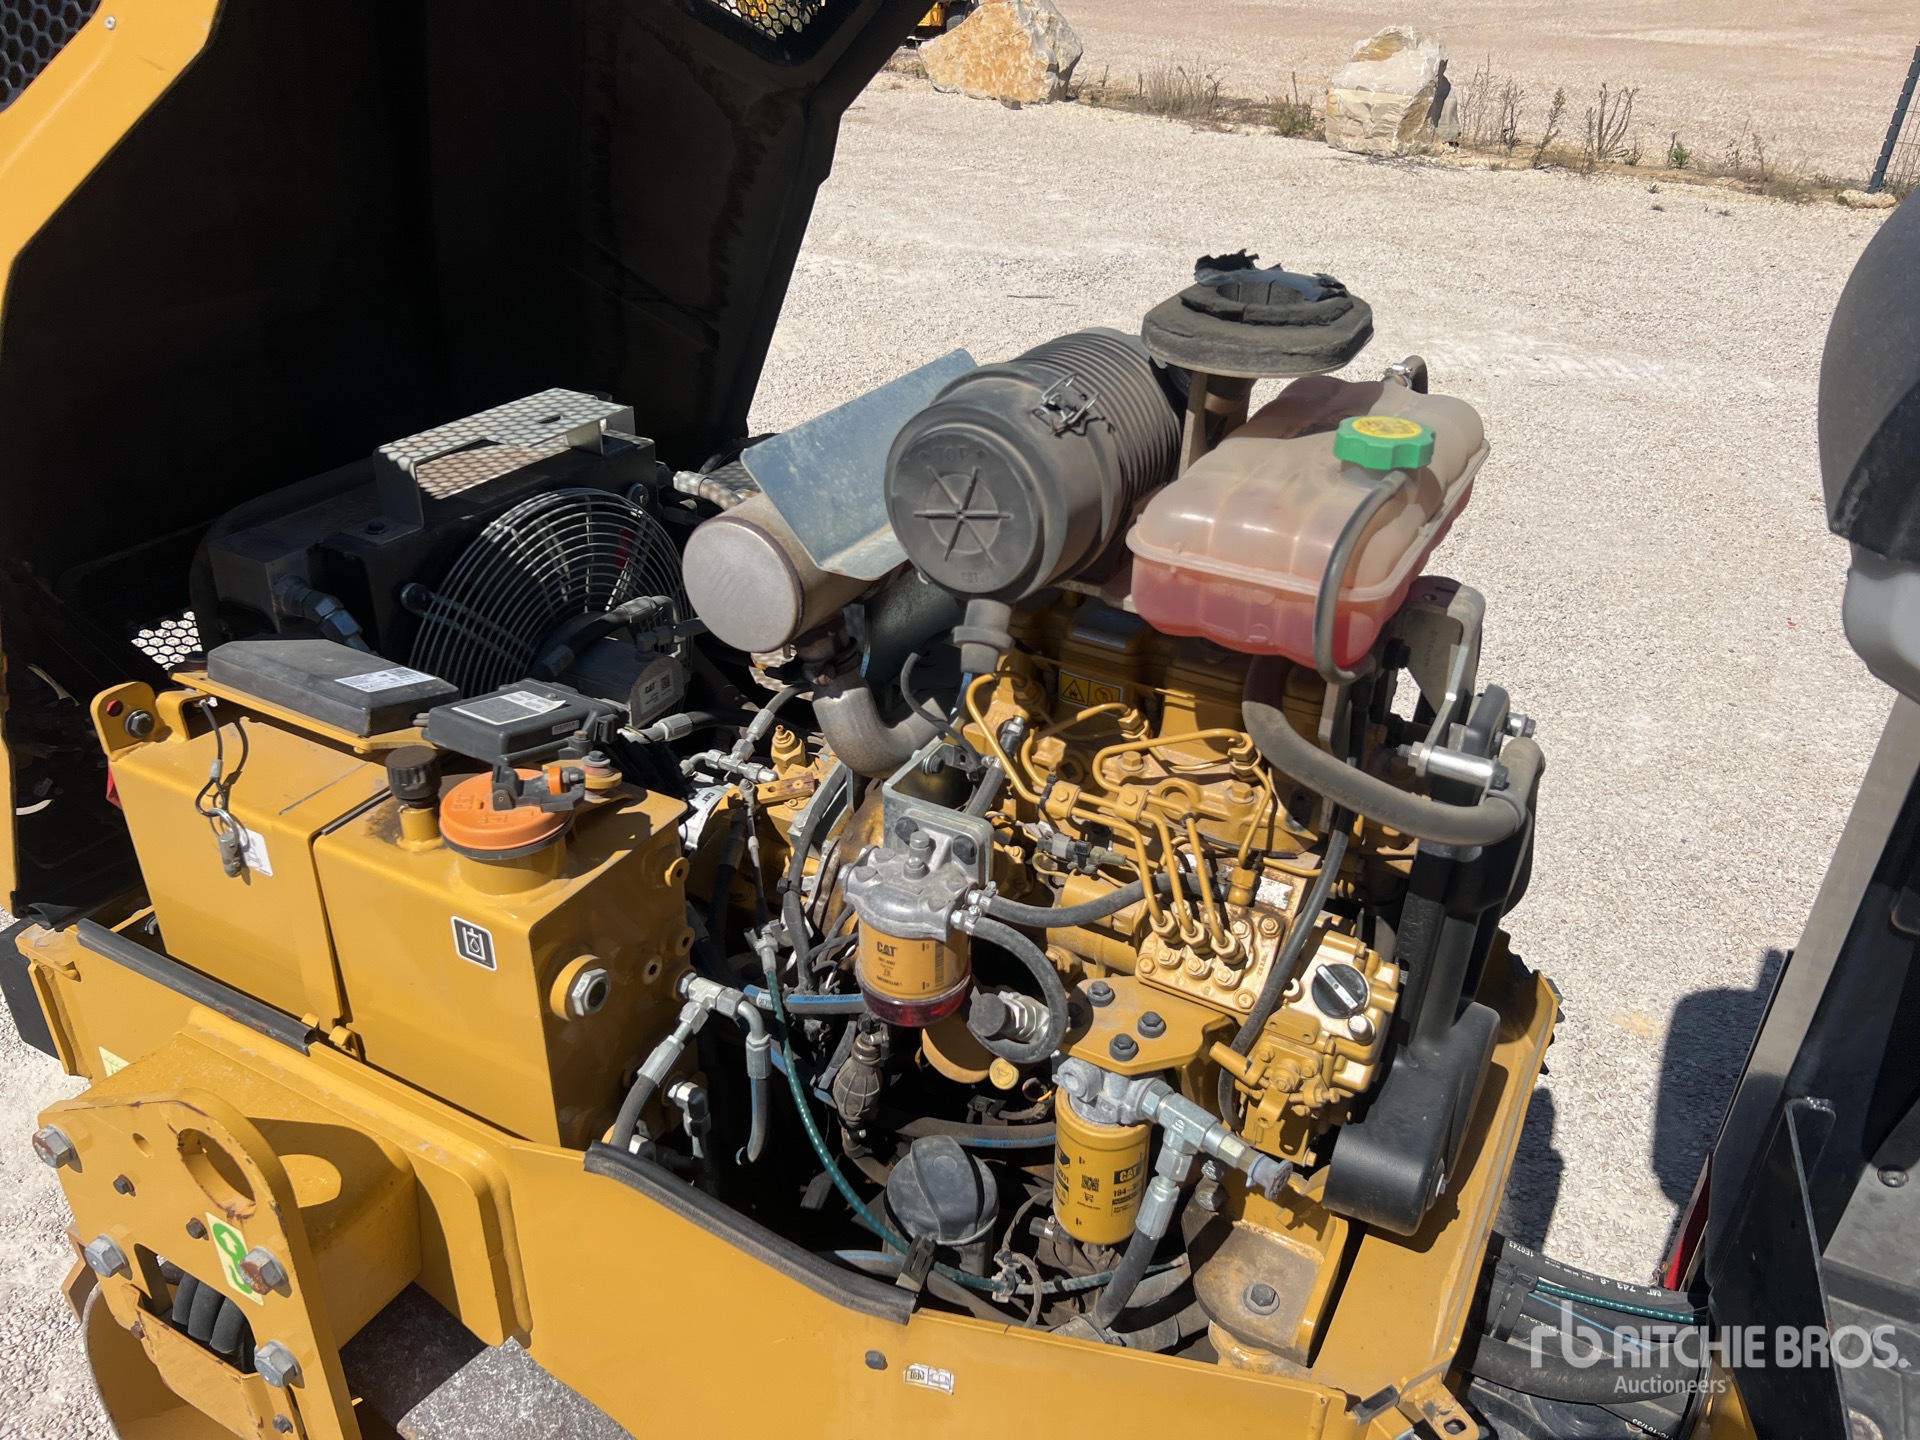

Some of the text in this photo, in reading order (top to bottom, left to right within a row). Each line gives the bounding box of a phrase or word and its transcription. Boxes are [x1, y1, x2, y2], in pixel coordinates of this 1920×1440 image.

[644, 682, 656, 694] CAT
[876, 941, 898, 958] CAT
[1119, 1166, 1137, 1182] CAT
[1616, 1281, 1637, 1293] 743
[1646, 1289, 1662, 1298] CAT
